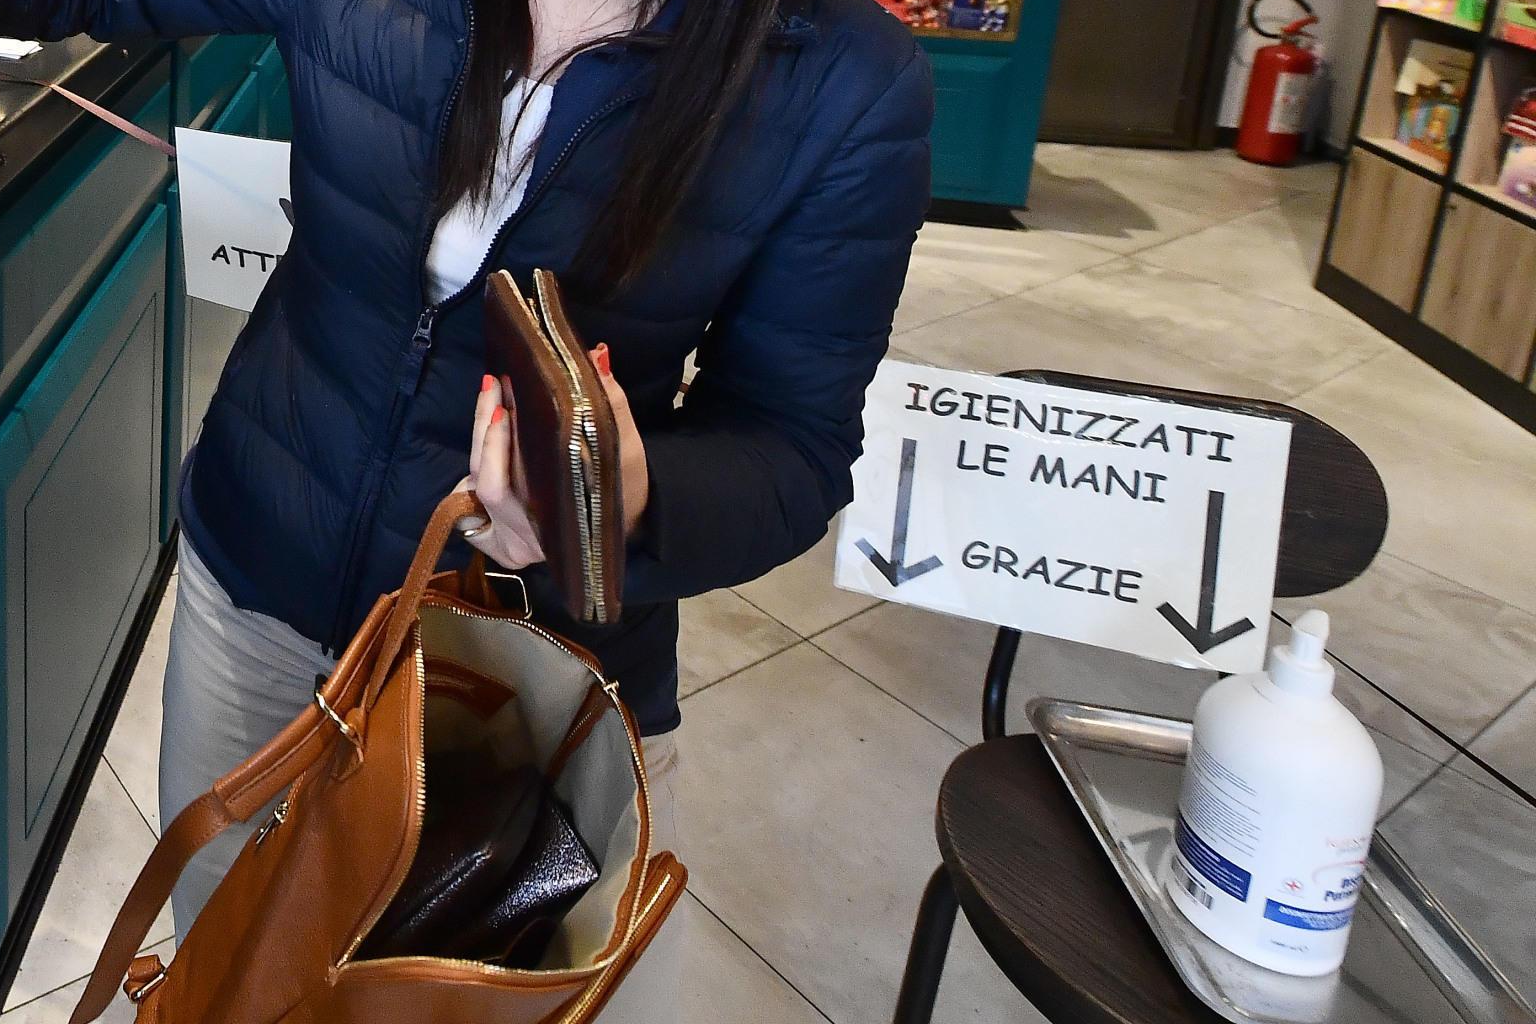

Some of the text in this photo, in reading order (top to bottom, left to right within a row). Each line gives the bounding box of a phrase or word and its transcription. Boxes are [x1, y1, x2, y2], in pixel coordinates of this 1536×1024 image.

[905, 382, 1235, 463] IGIENIZZATI
[956, 439, 1168, 504] LE MANI
[961, 540, 1144, 604] GRAZIE
